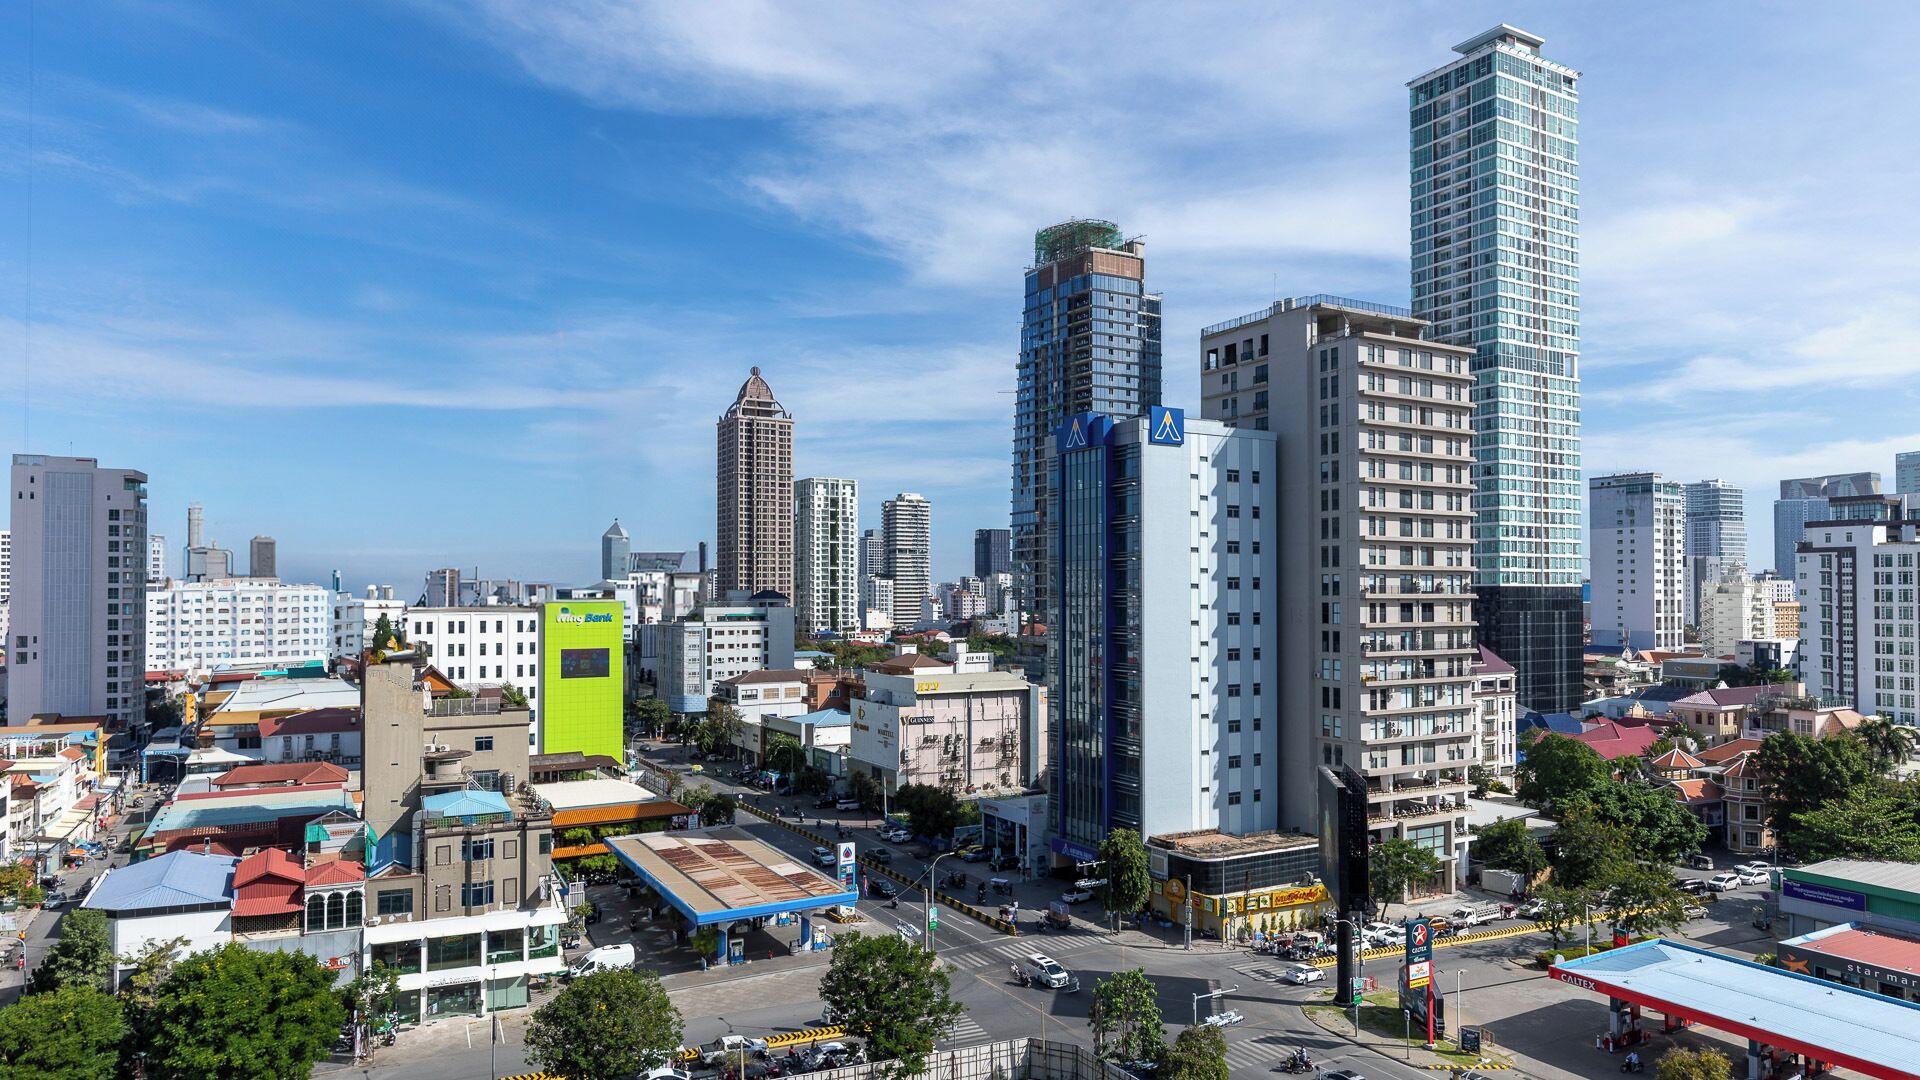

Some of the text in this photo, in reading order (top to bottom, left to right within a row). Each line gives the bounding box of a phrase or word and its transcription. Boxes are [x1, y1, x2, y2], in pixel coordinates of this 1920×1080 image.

[585, 613, 613, 623] Bank
[910, 715, 935, 724] GUINNESS
[1411, 946, 1427, 954] CALTEX
[1847, 963, 1880, 977] star
[1560, 973, 1597, 991] CALTEX
